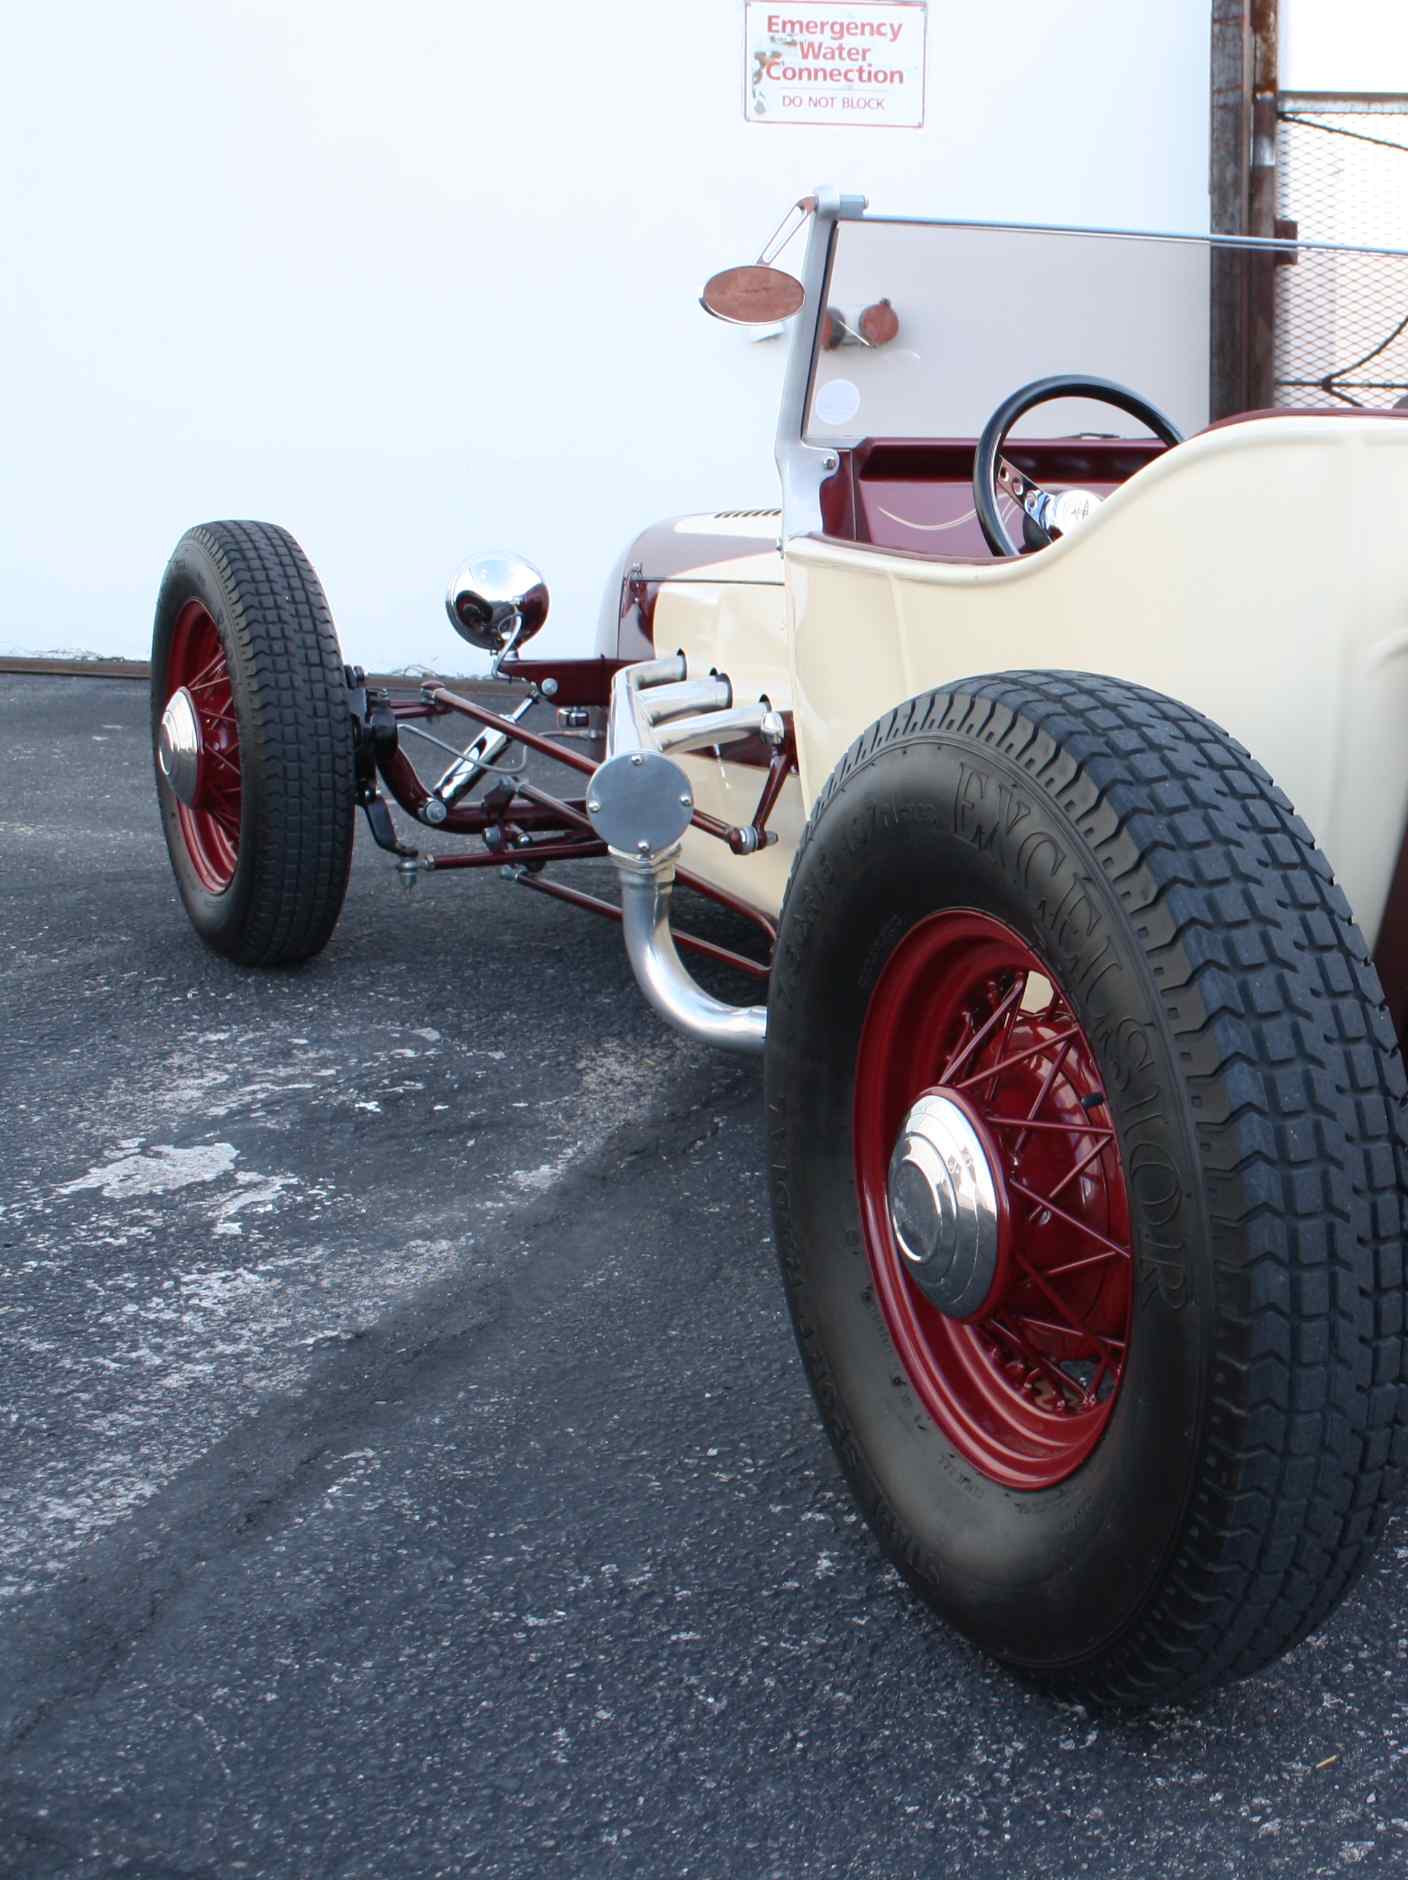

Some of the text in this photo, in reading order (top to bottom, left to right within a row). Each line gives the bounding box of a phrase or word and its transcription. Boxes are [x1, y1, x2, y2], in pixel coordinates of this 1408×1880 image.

[767, 15, 903, 42] Emergency
[799, 41, 871, 62] Water
[766, 62, 904, 84] Connection
[782, 95, 885, 110] DO NOT BLOCK
